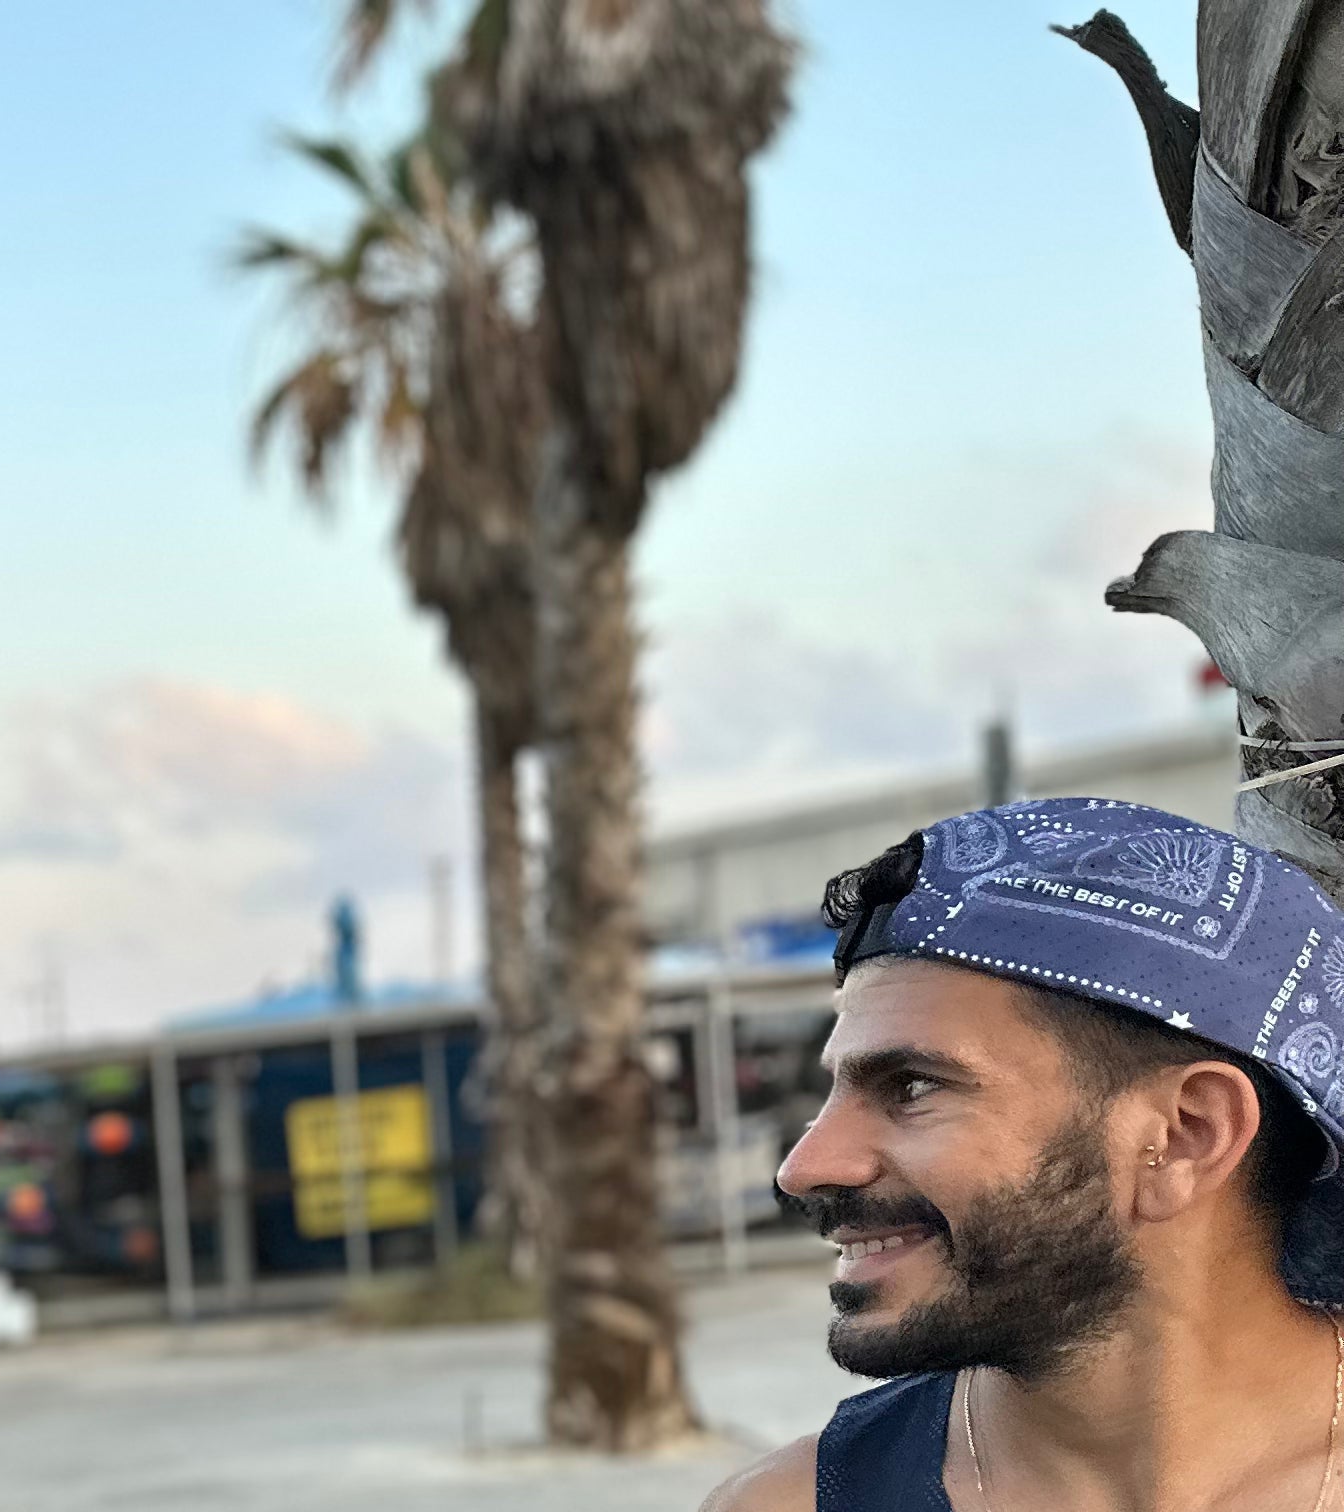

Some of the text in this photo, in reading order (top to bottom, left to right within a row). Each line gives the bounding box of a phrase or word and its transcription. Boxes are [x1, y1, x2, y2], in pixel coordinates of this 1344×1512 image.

[1227, 872, 1243, 894] OF
[1032, 879, 1073, 898] THE
[1074, 888, 1129, 910] BEST
[1131, 902, 1161, 918] OF
[1161, 911, 1183, 926] IT
[1218, 893, 1235, 911] IT
[1256, 1011, 1278, 1044] THE
[1271, 967, 1301, 1012] BEST
[1296, 944, 1312, 969] OF
[1307, 927, 1321, 946] IT
